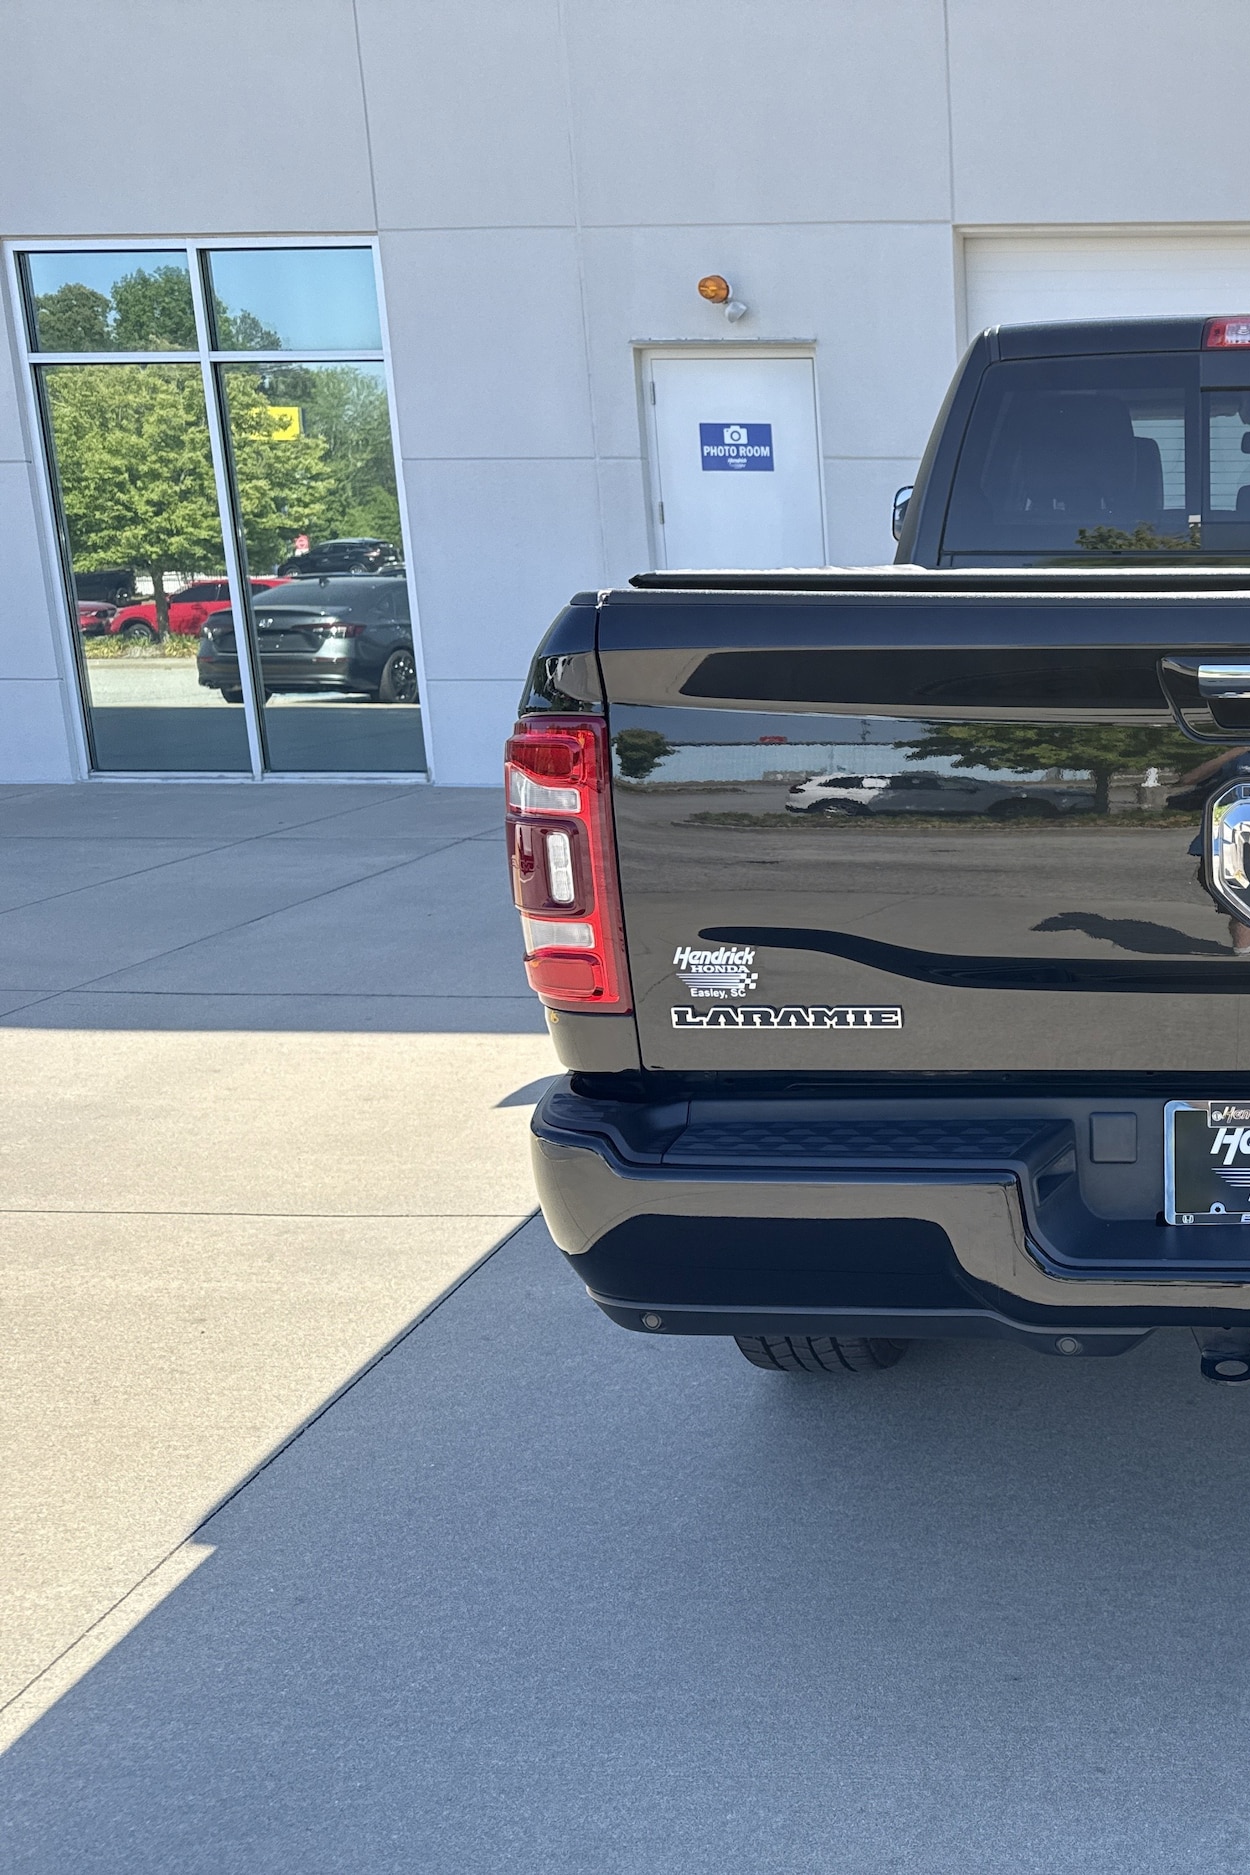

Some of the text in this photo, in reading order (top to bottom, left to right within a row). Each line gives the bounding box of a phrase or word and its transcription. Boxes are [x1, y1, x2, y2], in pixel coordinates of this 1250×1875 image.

[703, 445, 770, 457] PHOTO ROOM
[673, 946, 756, 970] Hendrick
[691, 965, 750, 973] HONDA
[690, 988, 746, 999] Easley, SC
[671, 1006, 903, 1029] LARAMIE
